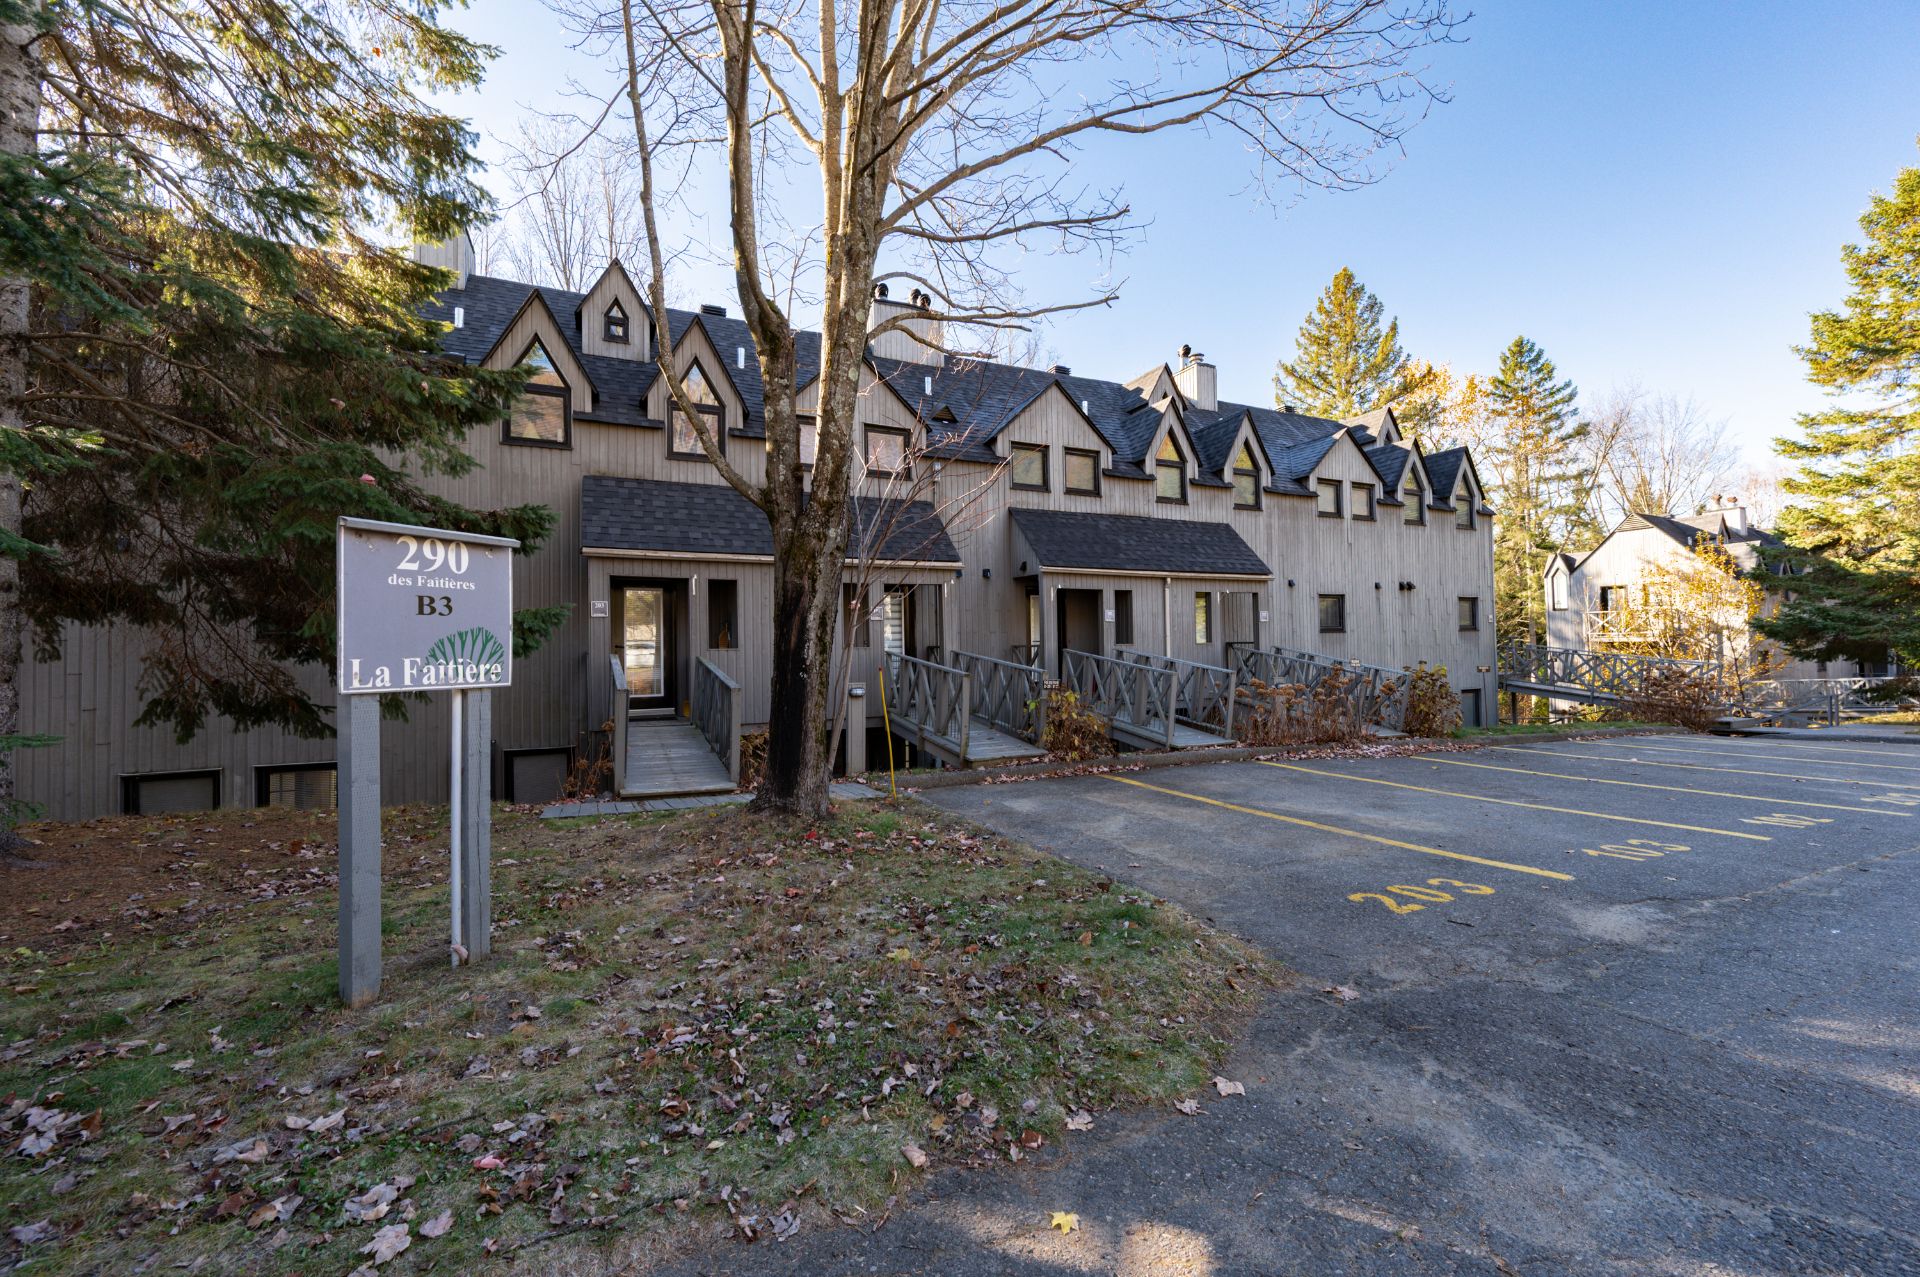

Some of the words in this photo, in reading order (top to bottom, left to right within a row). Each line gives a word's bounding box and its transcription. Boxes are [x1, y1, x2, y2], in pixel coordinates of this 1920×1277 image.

[396, 535, 469, 575] 290
[388, 574, 412, 587] des
[417, 575, 476, 591] Faîtières
[415, 595, 453, 617] B3
[349, 658, 392, 689] La
[402, 657, 502, 687] Faîtière
[1581, 838, 1692, 861] 103
[1346, 878, 1496, 915] 203
